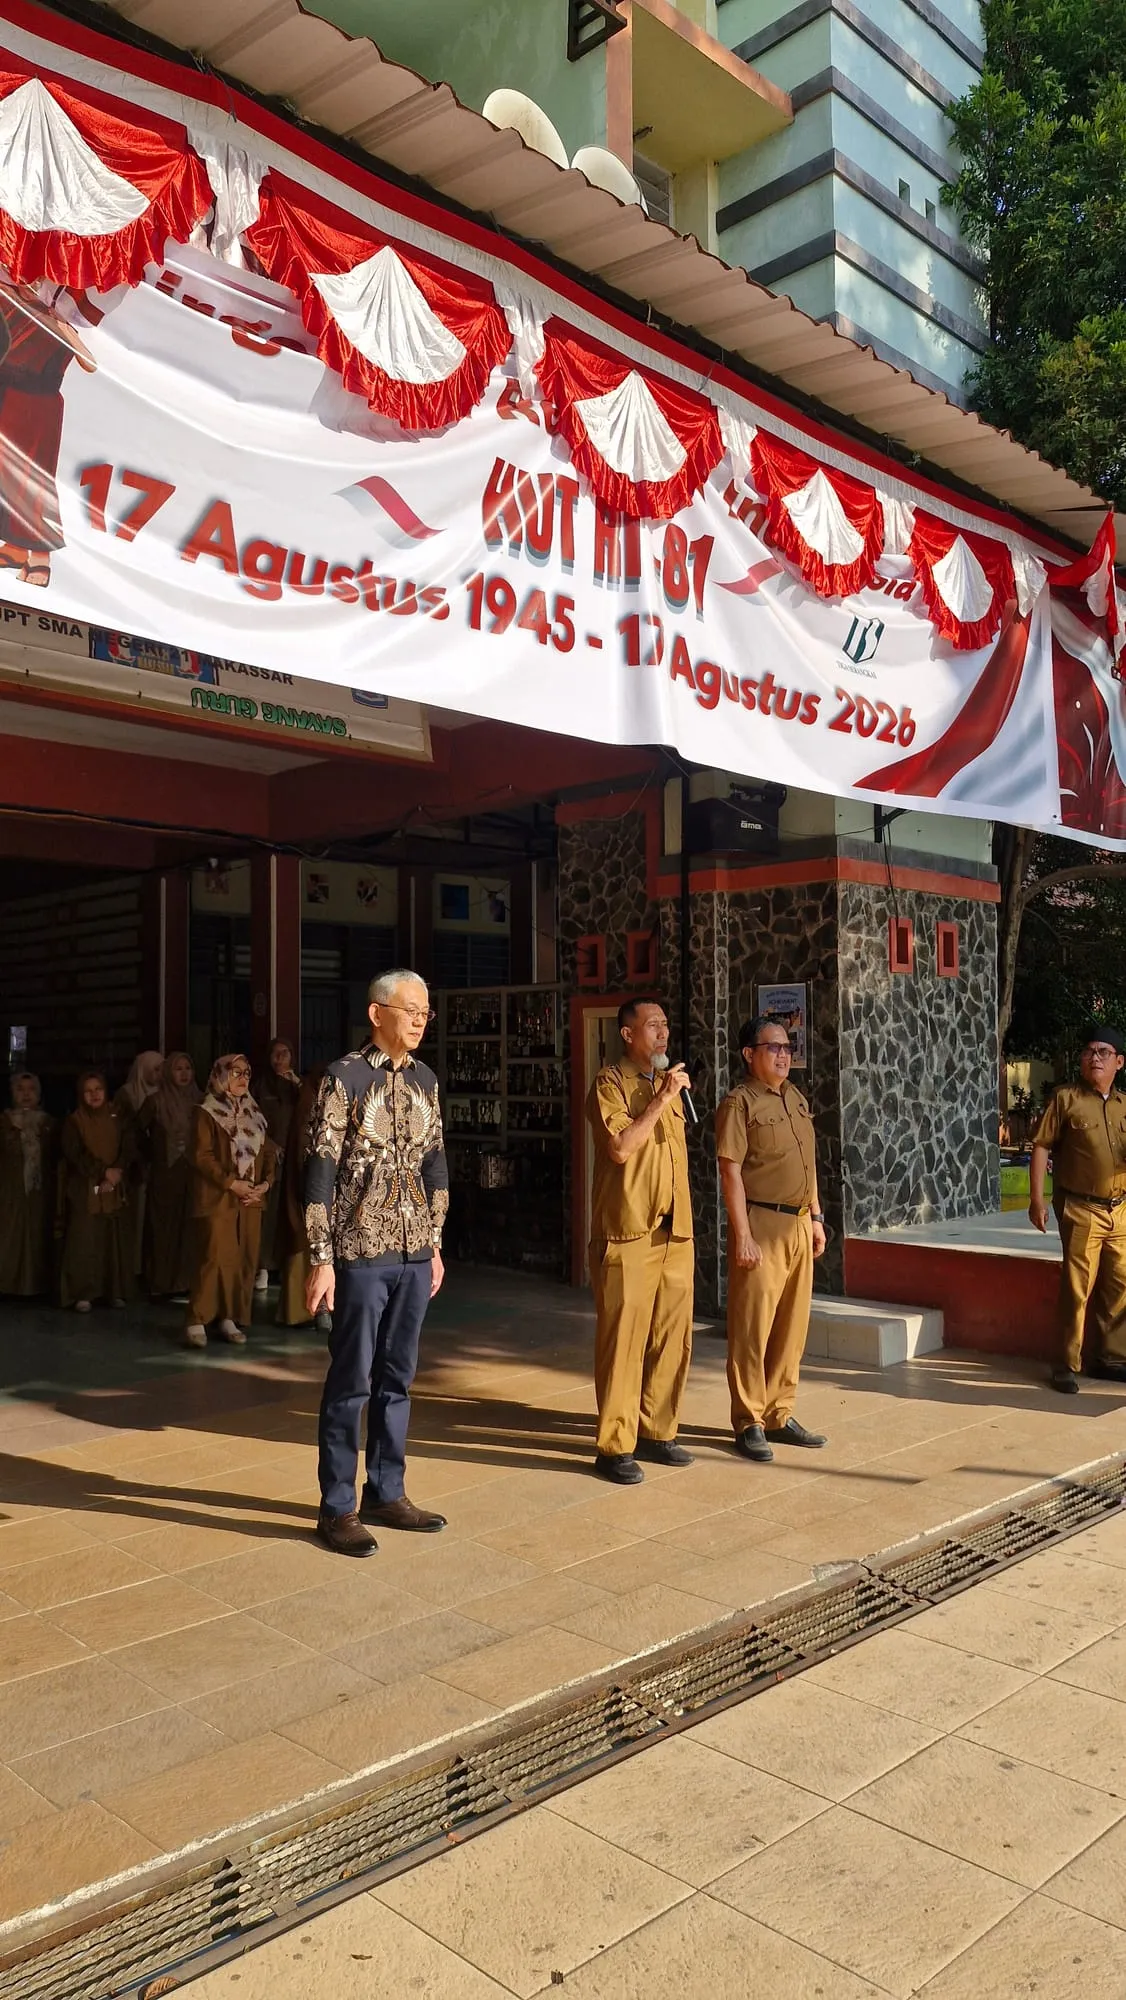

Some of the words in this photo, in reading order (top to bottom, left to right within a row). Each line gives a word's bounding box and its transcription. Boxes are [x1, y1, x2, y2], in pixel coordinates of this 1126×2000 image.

[482, 457, 580, 568] HUT
[0, 607, 30, 627] PT
[38, 616, 83, 638] SMA
[80, 463, 176, 542] 17
[180, 499, 450, 620] Agustus
[466, 571, 575, 653] 1945
[670, 635, 821, 725] Agustus
[828, 687, 917, 748] 2026
[190, 688, 258, 720] GURU
[261, 702, 347, 737] SAYANG
